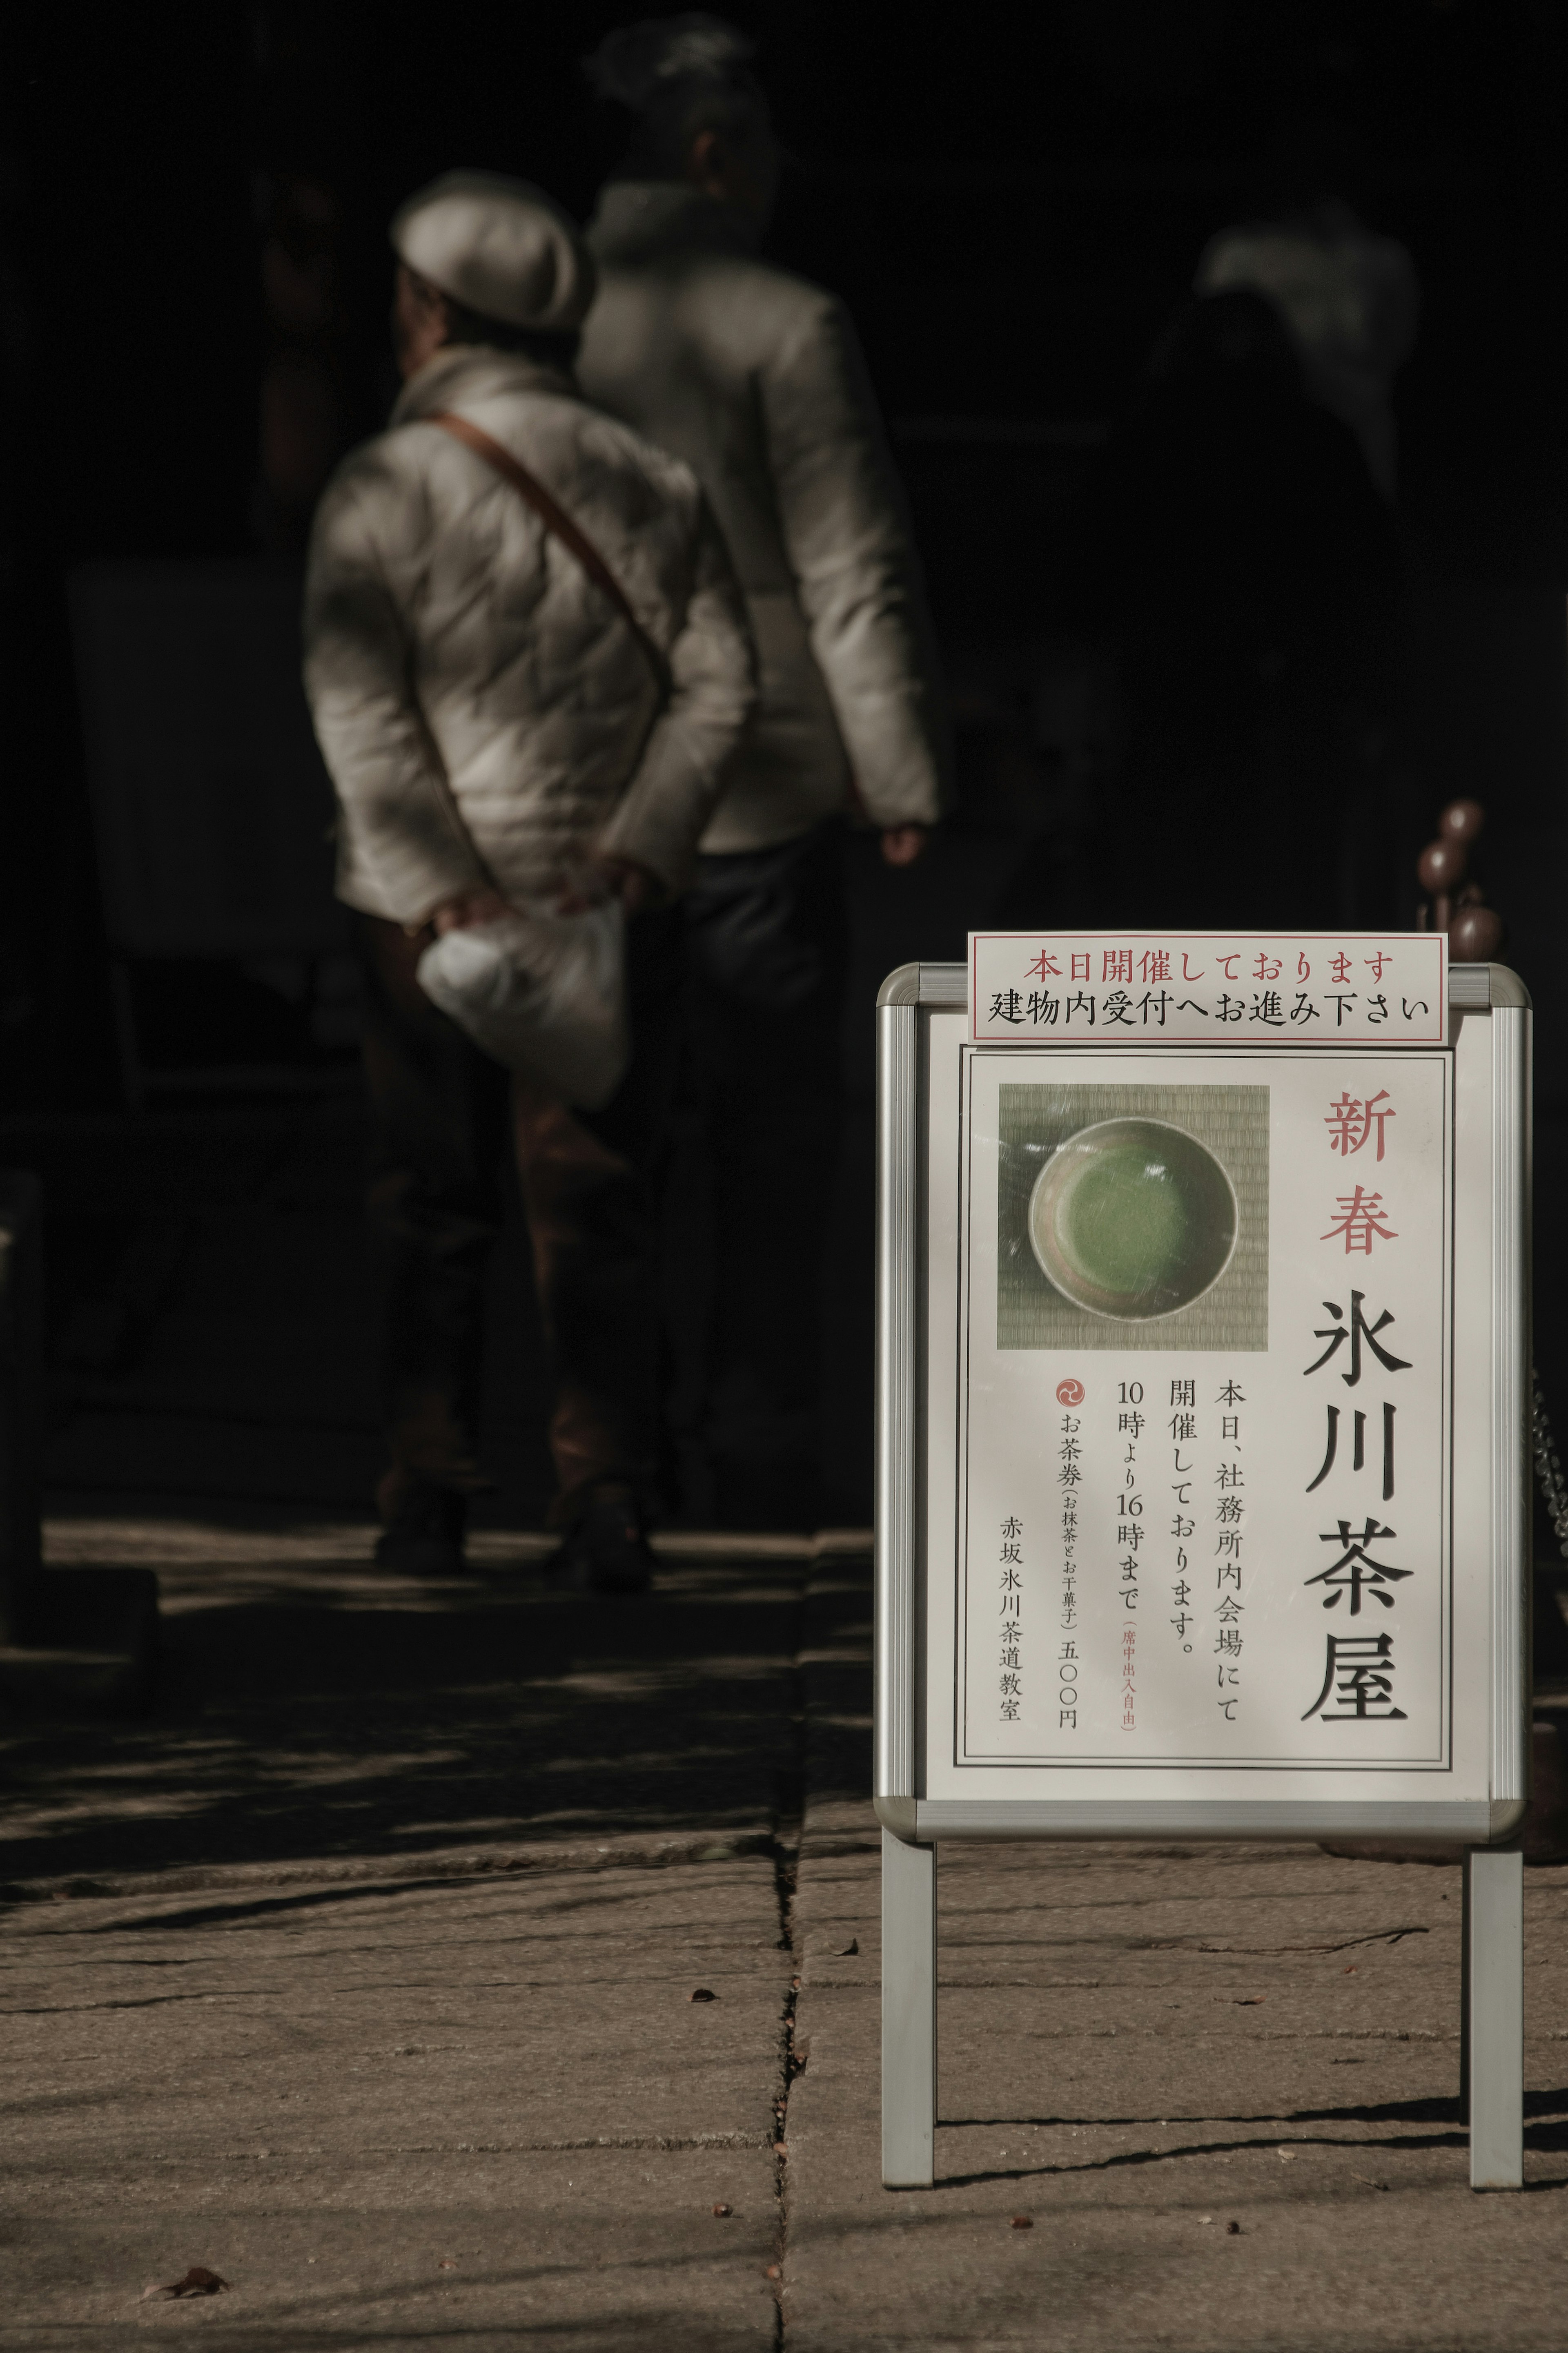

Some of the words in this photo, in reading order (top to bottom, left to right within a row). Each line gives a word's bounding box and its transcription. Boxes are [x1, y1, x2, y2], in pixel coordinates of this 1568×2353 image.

[987, 988, 1429, 1027] 建物内受付へお進み下さい
[1023, 949, 1394, 985] 本日開催しております
[998, 1516, 1025, 1721] 赤坂氷川茶道教室
[1167, 1379, 1198, 1655] 開催しております。
[1213, 1379, 1247, 1721] 本日、社務所内会場にて
